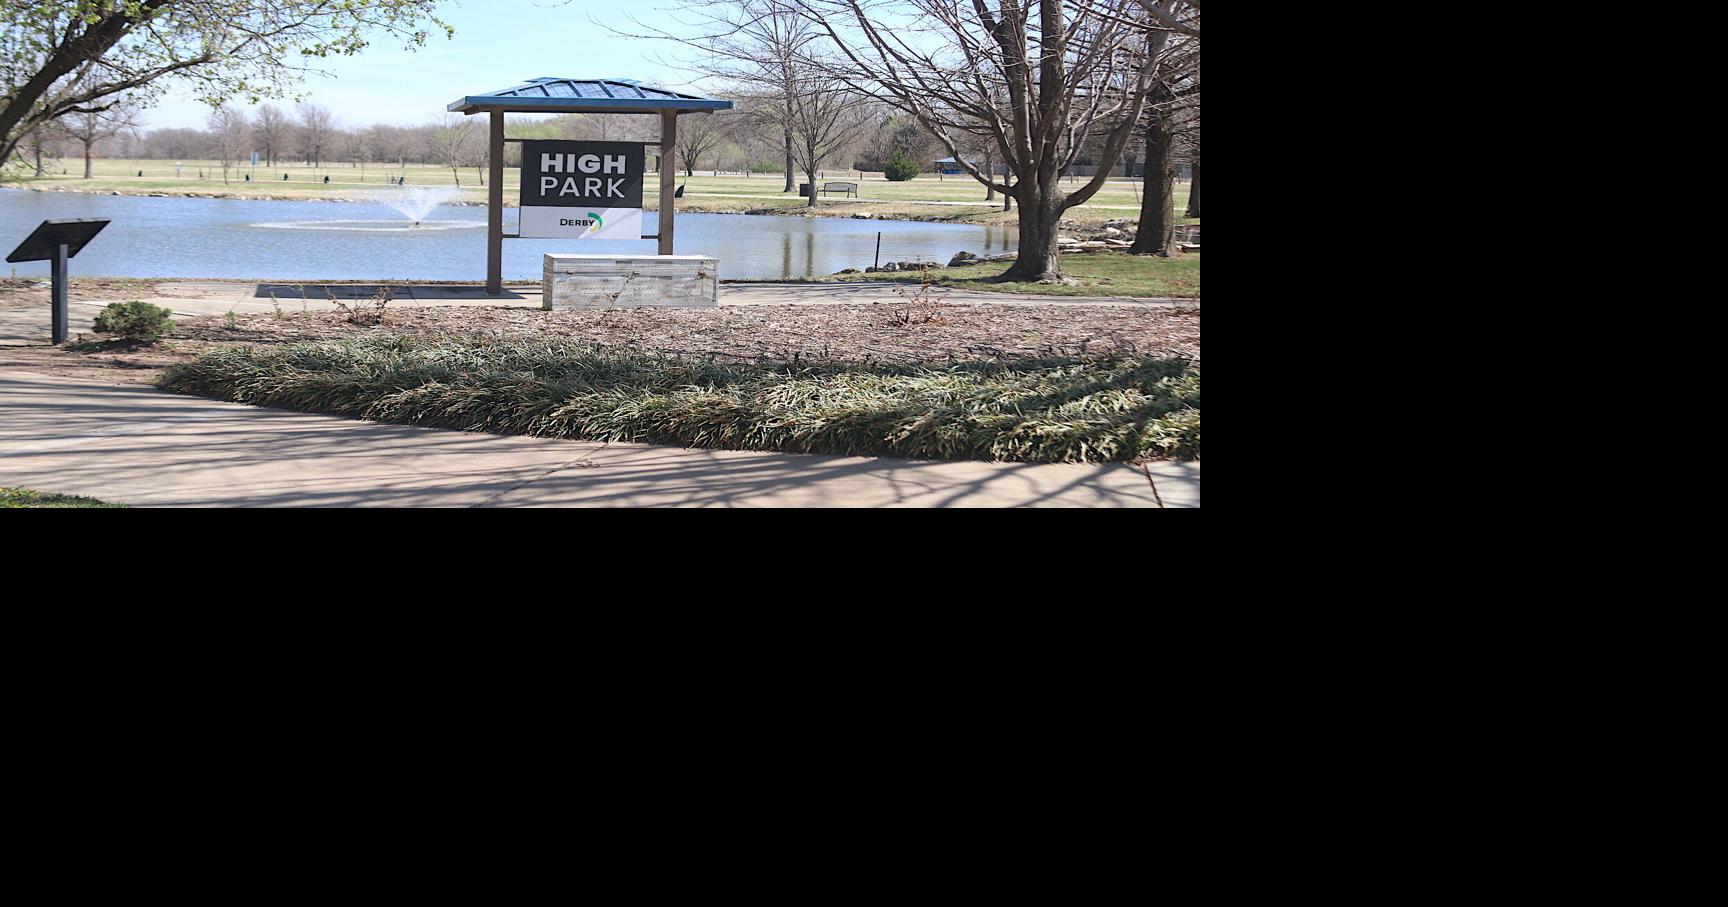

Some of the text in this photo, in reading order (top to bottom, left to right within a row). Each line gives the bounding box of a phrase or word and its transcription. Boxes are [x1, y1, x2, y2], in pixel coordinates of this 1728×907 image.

[540, 152, 626, 175] HIGH
[540, 176, 627, 198] PARK
[559, 218, 595, 227] DERBY
